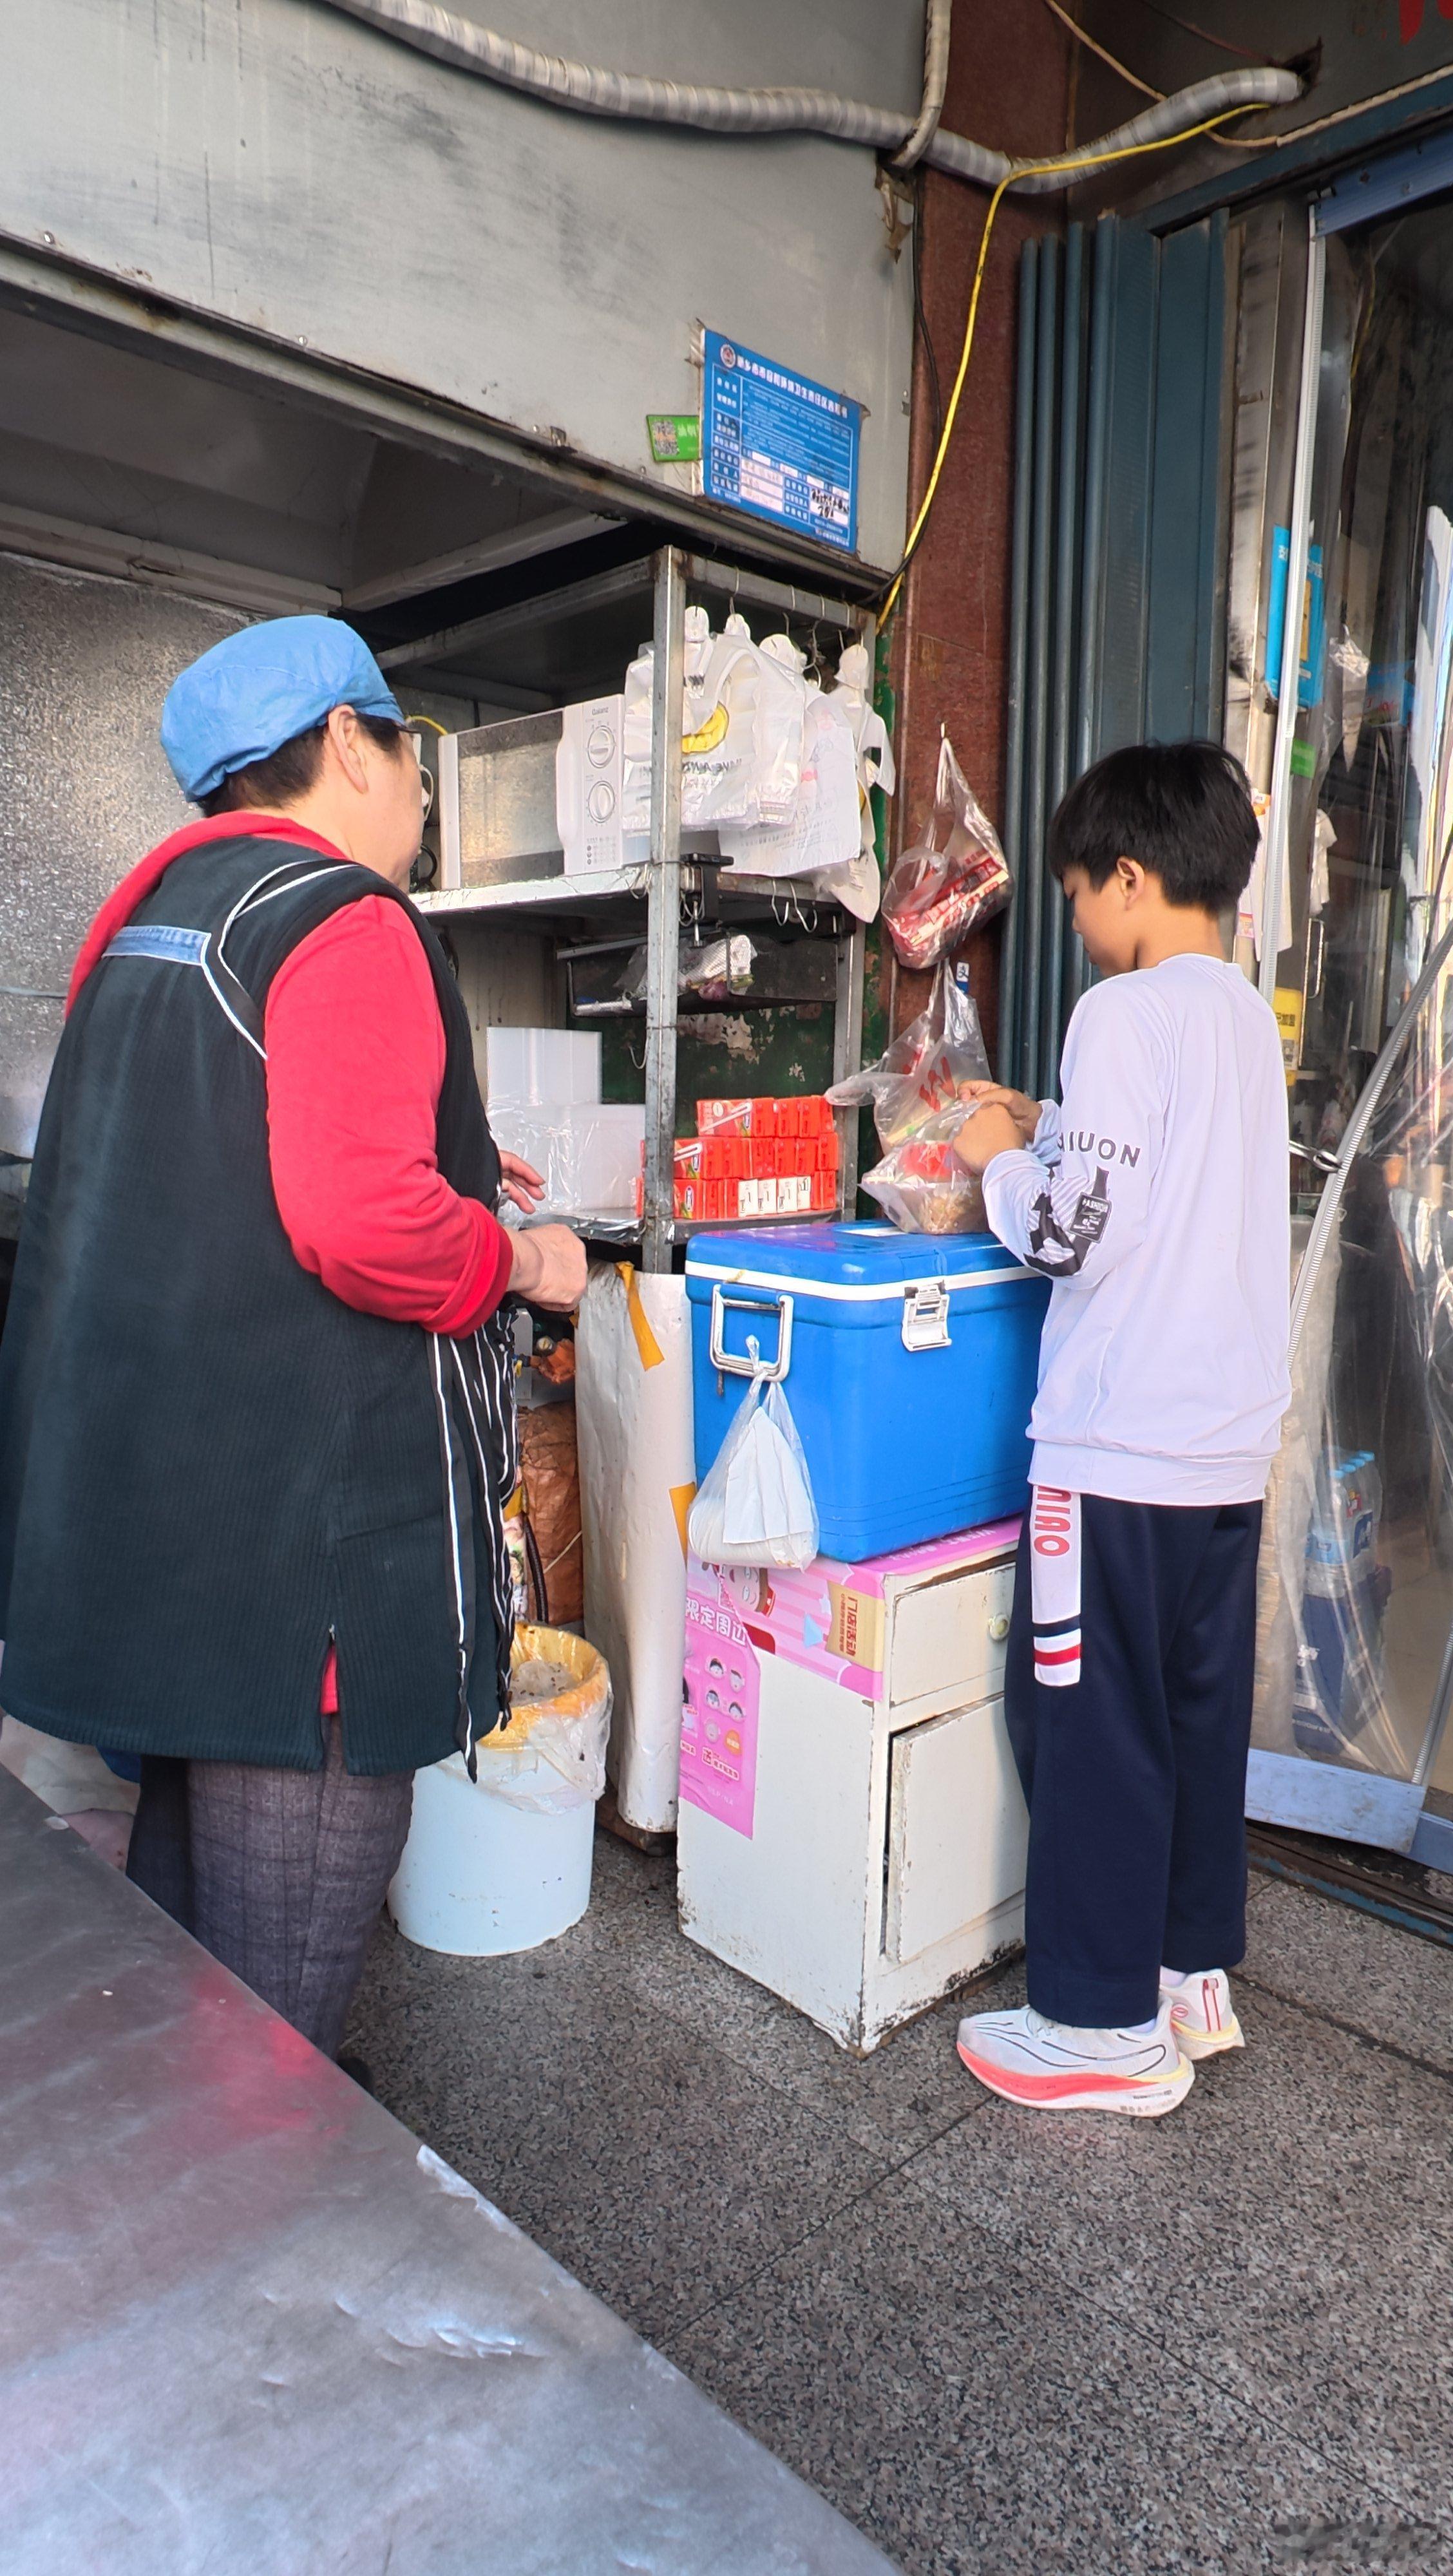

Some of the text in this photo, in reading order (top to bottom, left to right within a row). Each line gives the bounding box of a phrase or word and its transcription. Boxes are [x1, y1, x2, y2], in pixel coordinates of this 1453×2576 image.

[685, 1596, 746, 1646] 限定周边
[846, 1596, 858, 1656] 门店活动
